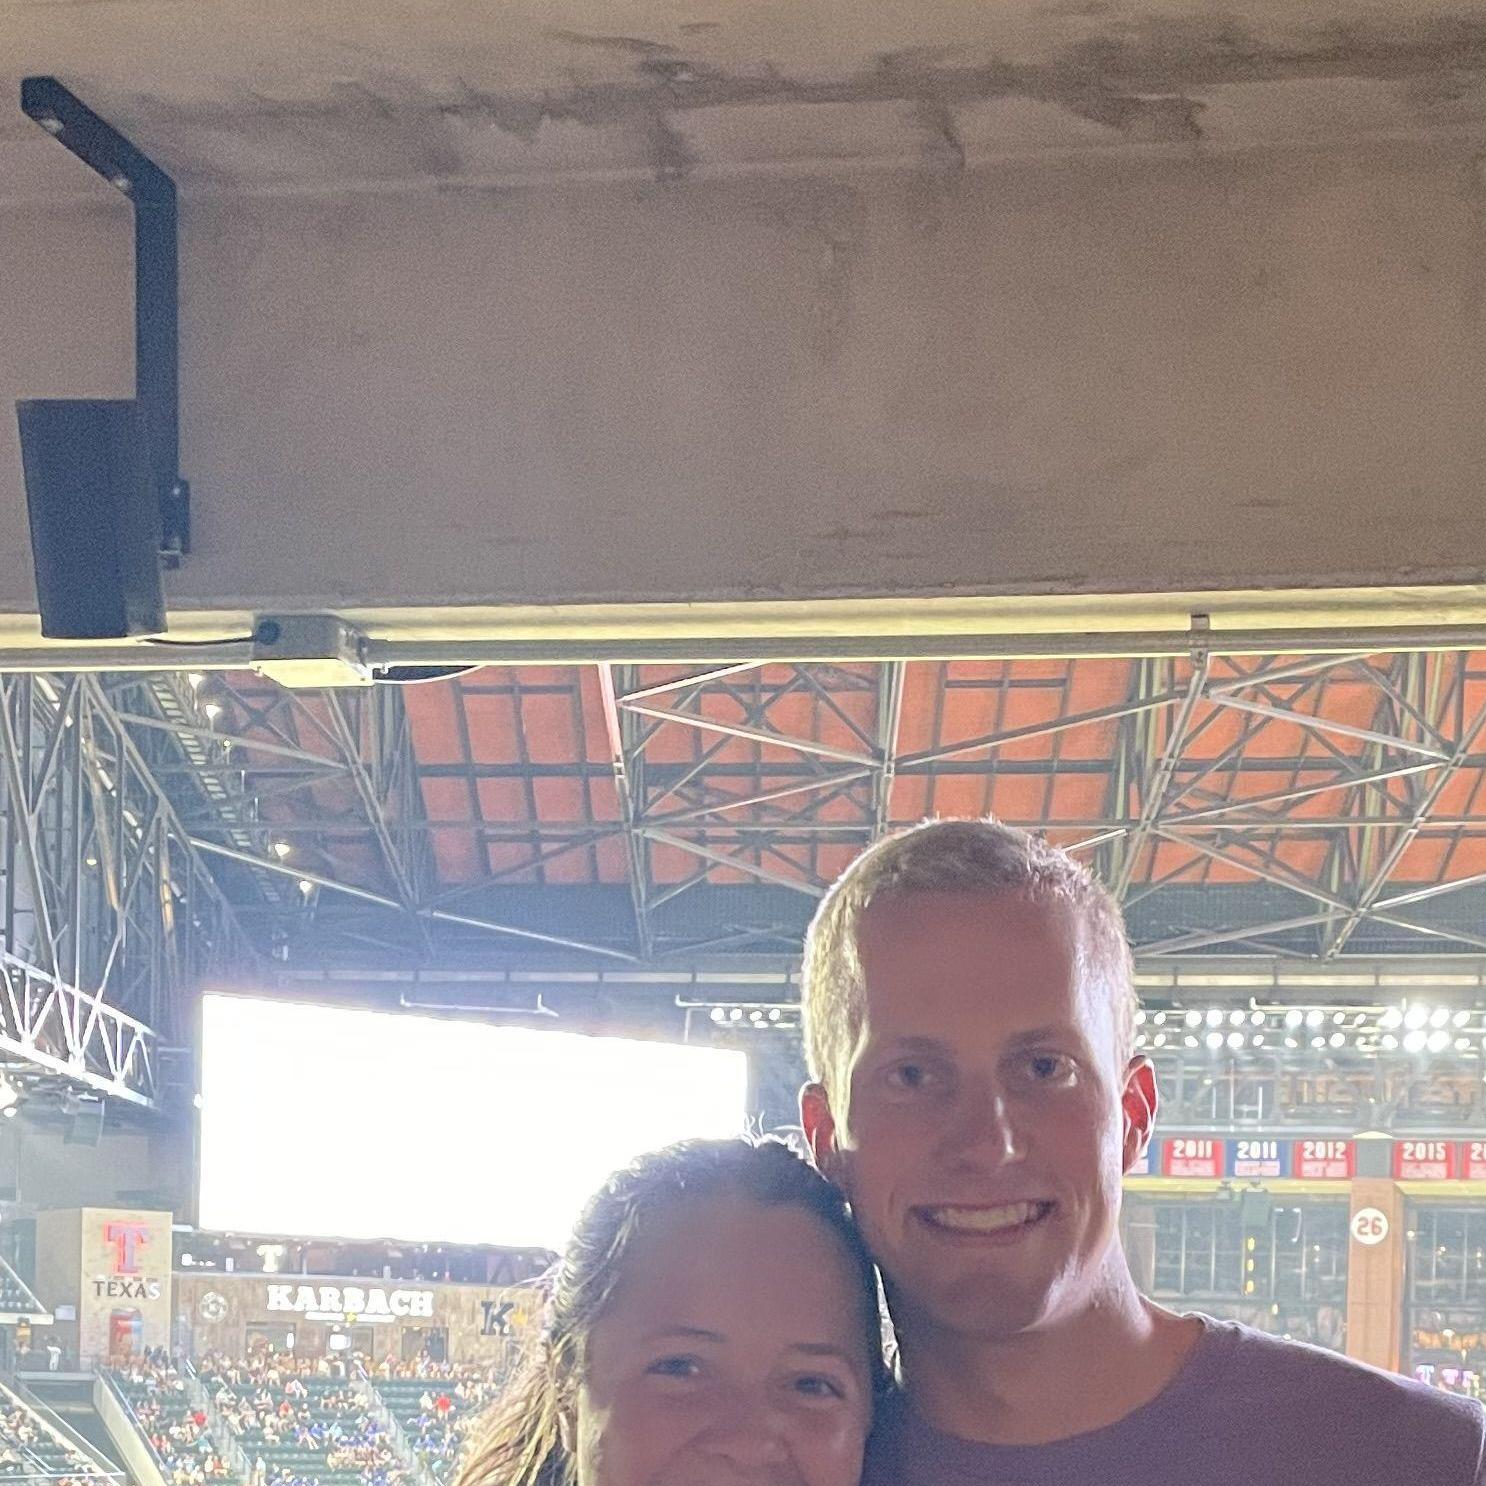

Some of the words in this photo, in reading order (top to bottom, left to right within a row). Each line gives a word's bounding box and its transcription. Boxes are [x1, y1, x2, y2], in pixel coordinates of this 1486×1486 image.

[1172, 1139, 1213, 1158] 2011
[1236, 1141, 1278, 1159] 2011
[1303, 1141, 1346, 1159] 2012
[1403, 1142, 1446, 1160] 2015
[1357, 1216, 1383, 1236] 26
[93, 1280, 161, 1300] TEXAS
[266, 1284, 434, 1317] KARBACH
